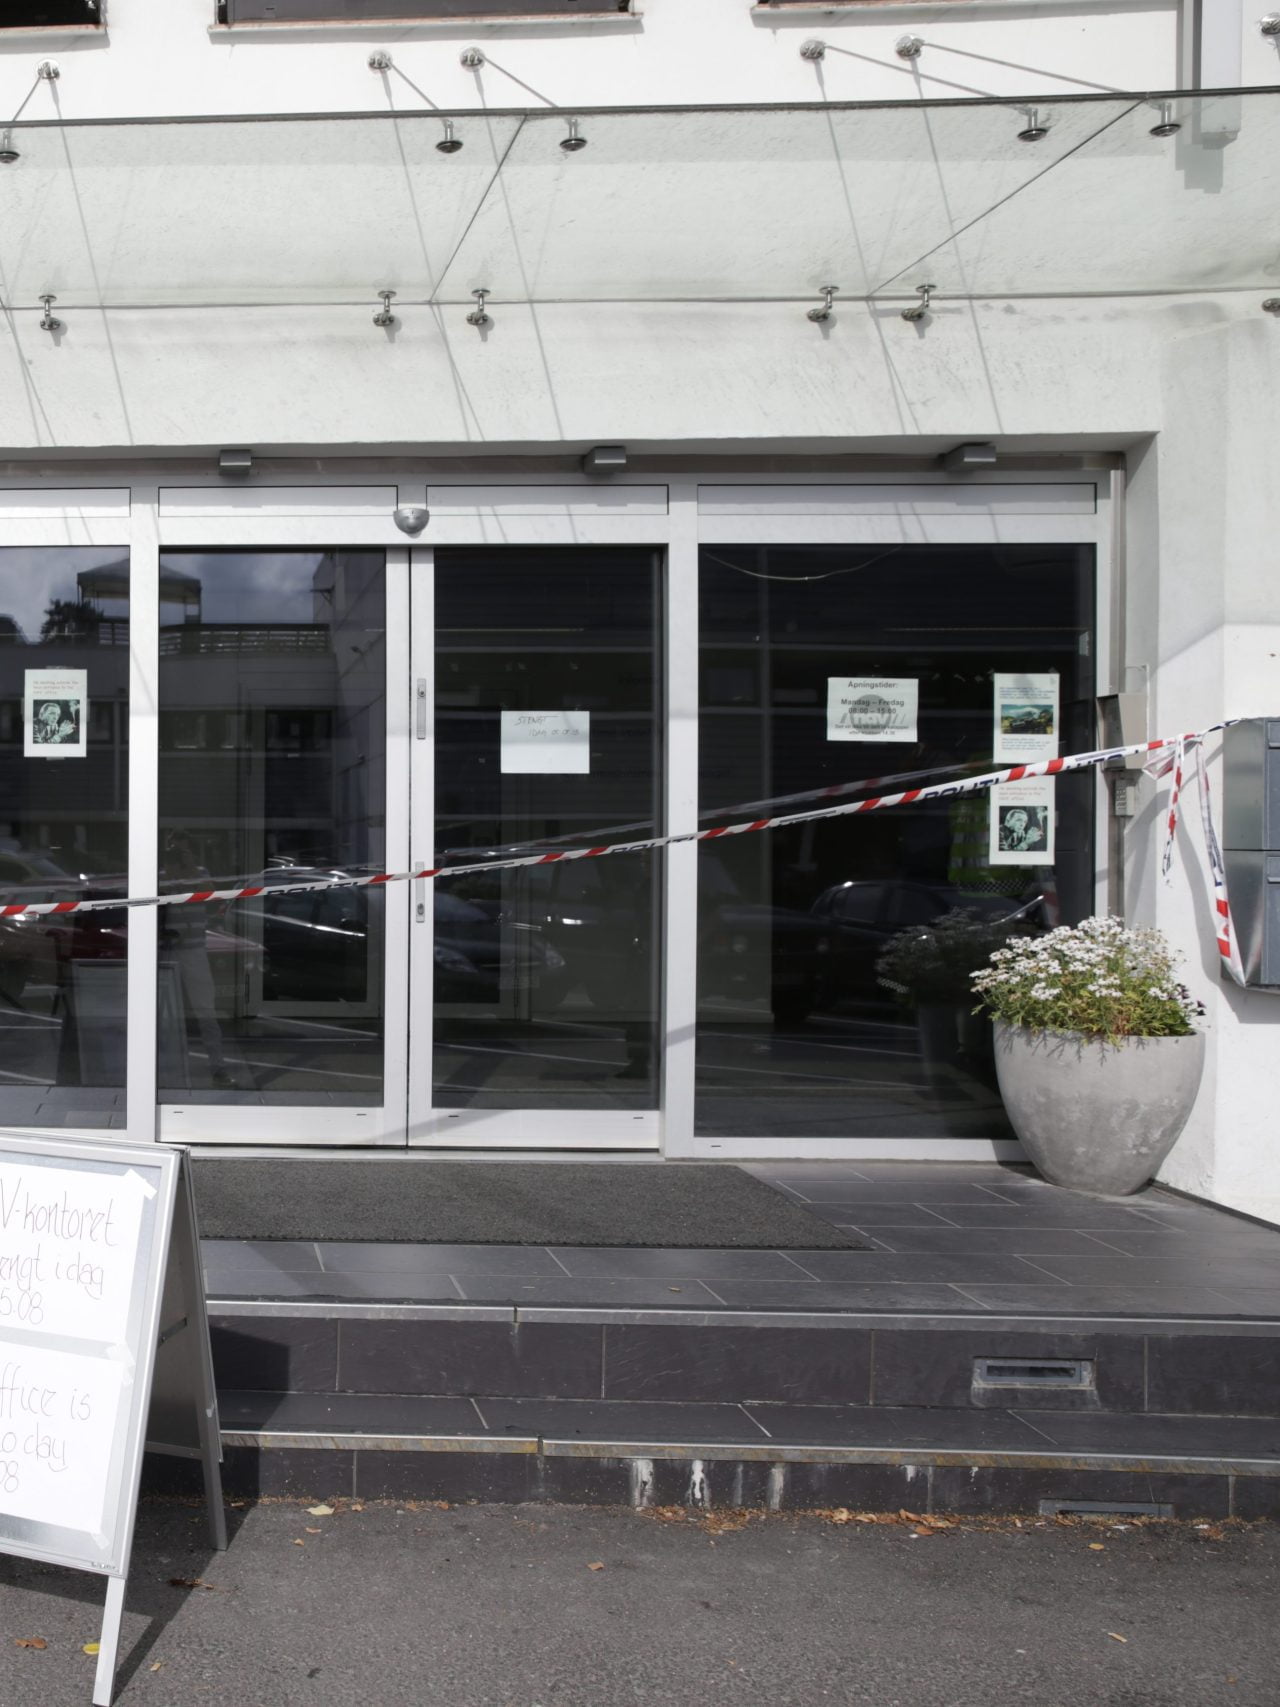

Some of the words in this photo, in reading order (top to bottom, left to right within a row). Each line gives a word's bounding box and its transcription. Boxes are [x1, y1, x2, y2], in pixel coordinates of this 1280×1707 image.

[841, 698, 870, 707] Mandag
[878, 698, 905, 707] Fredag
[70, 1388, 91, 1421] is
